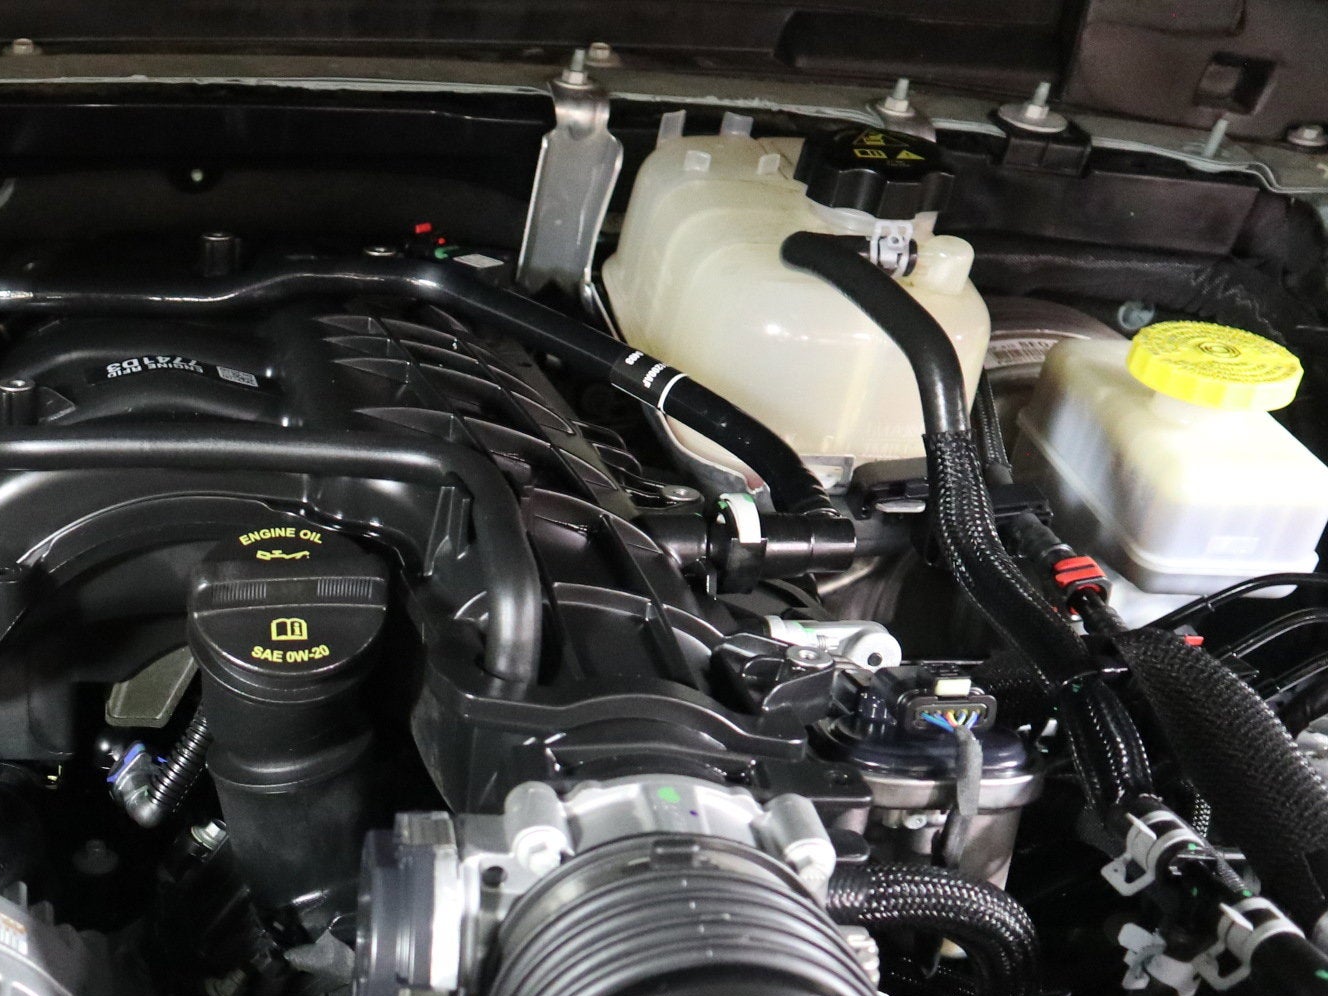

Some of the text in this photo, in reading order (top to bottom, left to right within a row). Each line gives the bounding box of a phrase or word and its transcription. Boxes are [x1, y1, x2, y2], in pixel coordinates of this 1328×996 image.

[106, 363, 204, 378] ENGINE RFID
[239, 527, 323, 546] ENGINE OIL
[251, 644, 330, 663] SAE 0W-20
